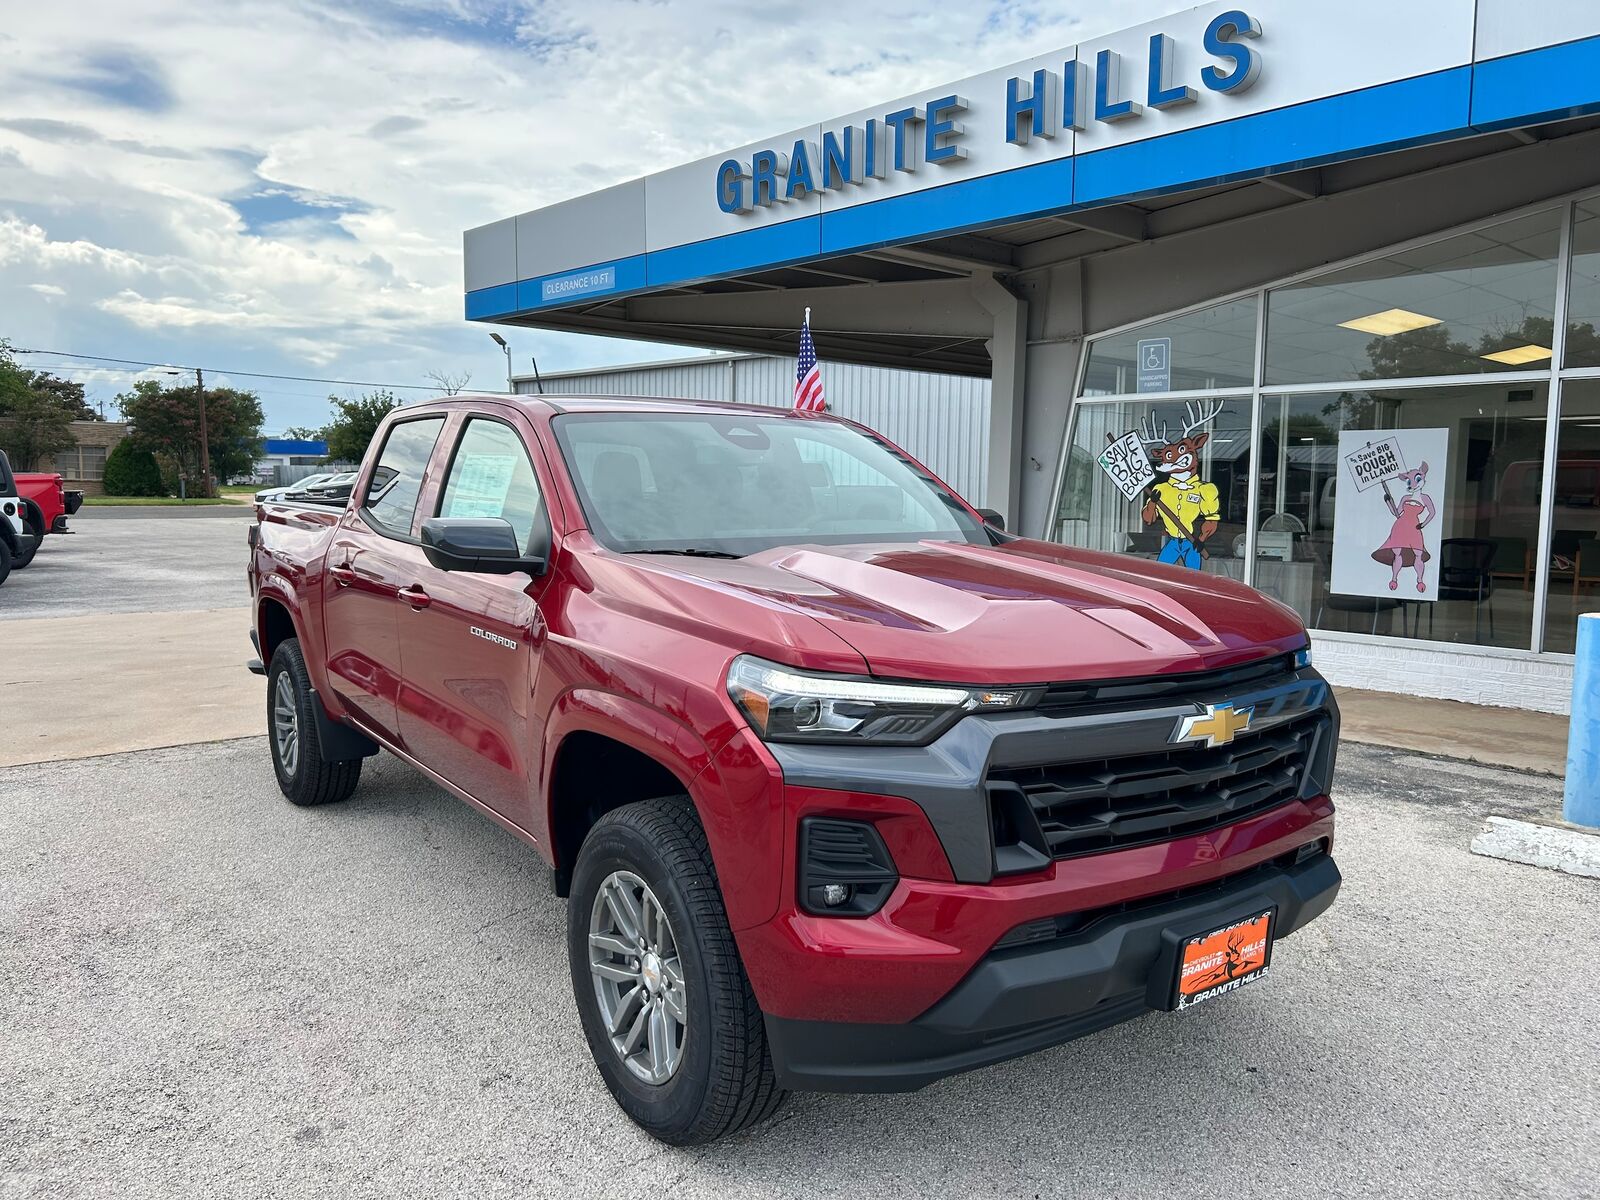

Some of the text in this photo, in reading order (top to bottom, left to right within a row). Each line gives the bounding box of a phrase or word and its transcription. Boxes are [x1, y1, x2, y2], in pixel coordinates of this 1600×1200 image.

[716, 10, 1262, 216] GRANITE HILLS
[546, 272, 609, 294] CLEARANCE 10 FT
[1105, 435, 1139, 465] SAVE
[1357, 450, 1376, 462] Save
[1376, 443, 1390, 454] BIG
[1111, 451, 1143, 482] BIG
[1355, 451, 1396, 476] DOUGH
[1370, 462, 1400, 480] LLANO!
[1121, 463, 1153, 496] BUCKS
[470, 625, 517, 650] COLORADO
[1240, 938, 1266, 956] HILLS
[1193, 966, 1269, 1004] GRANITE HILLS
